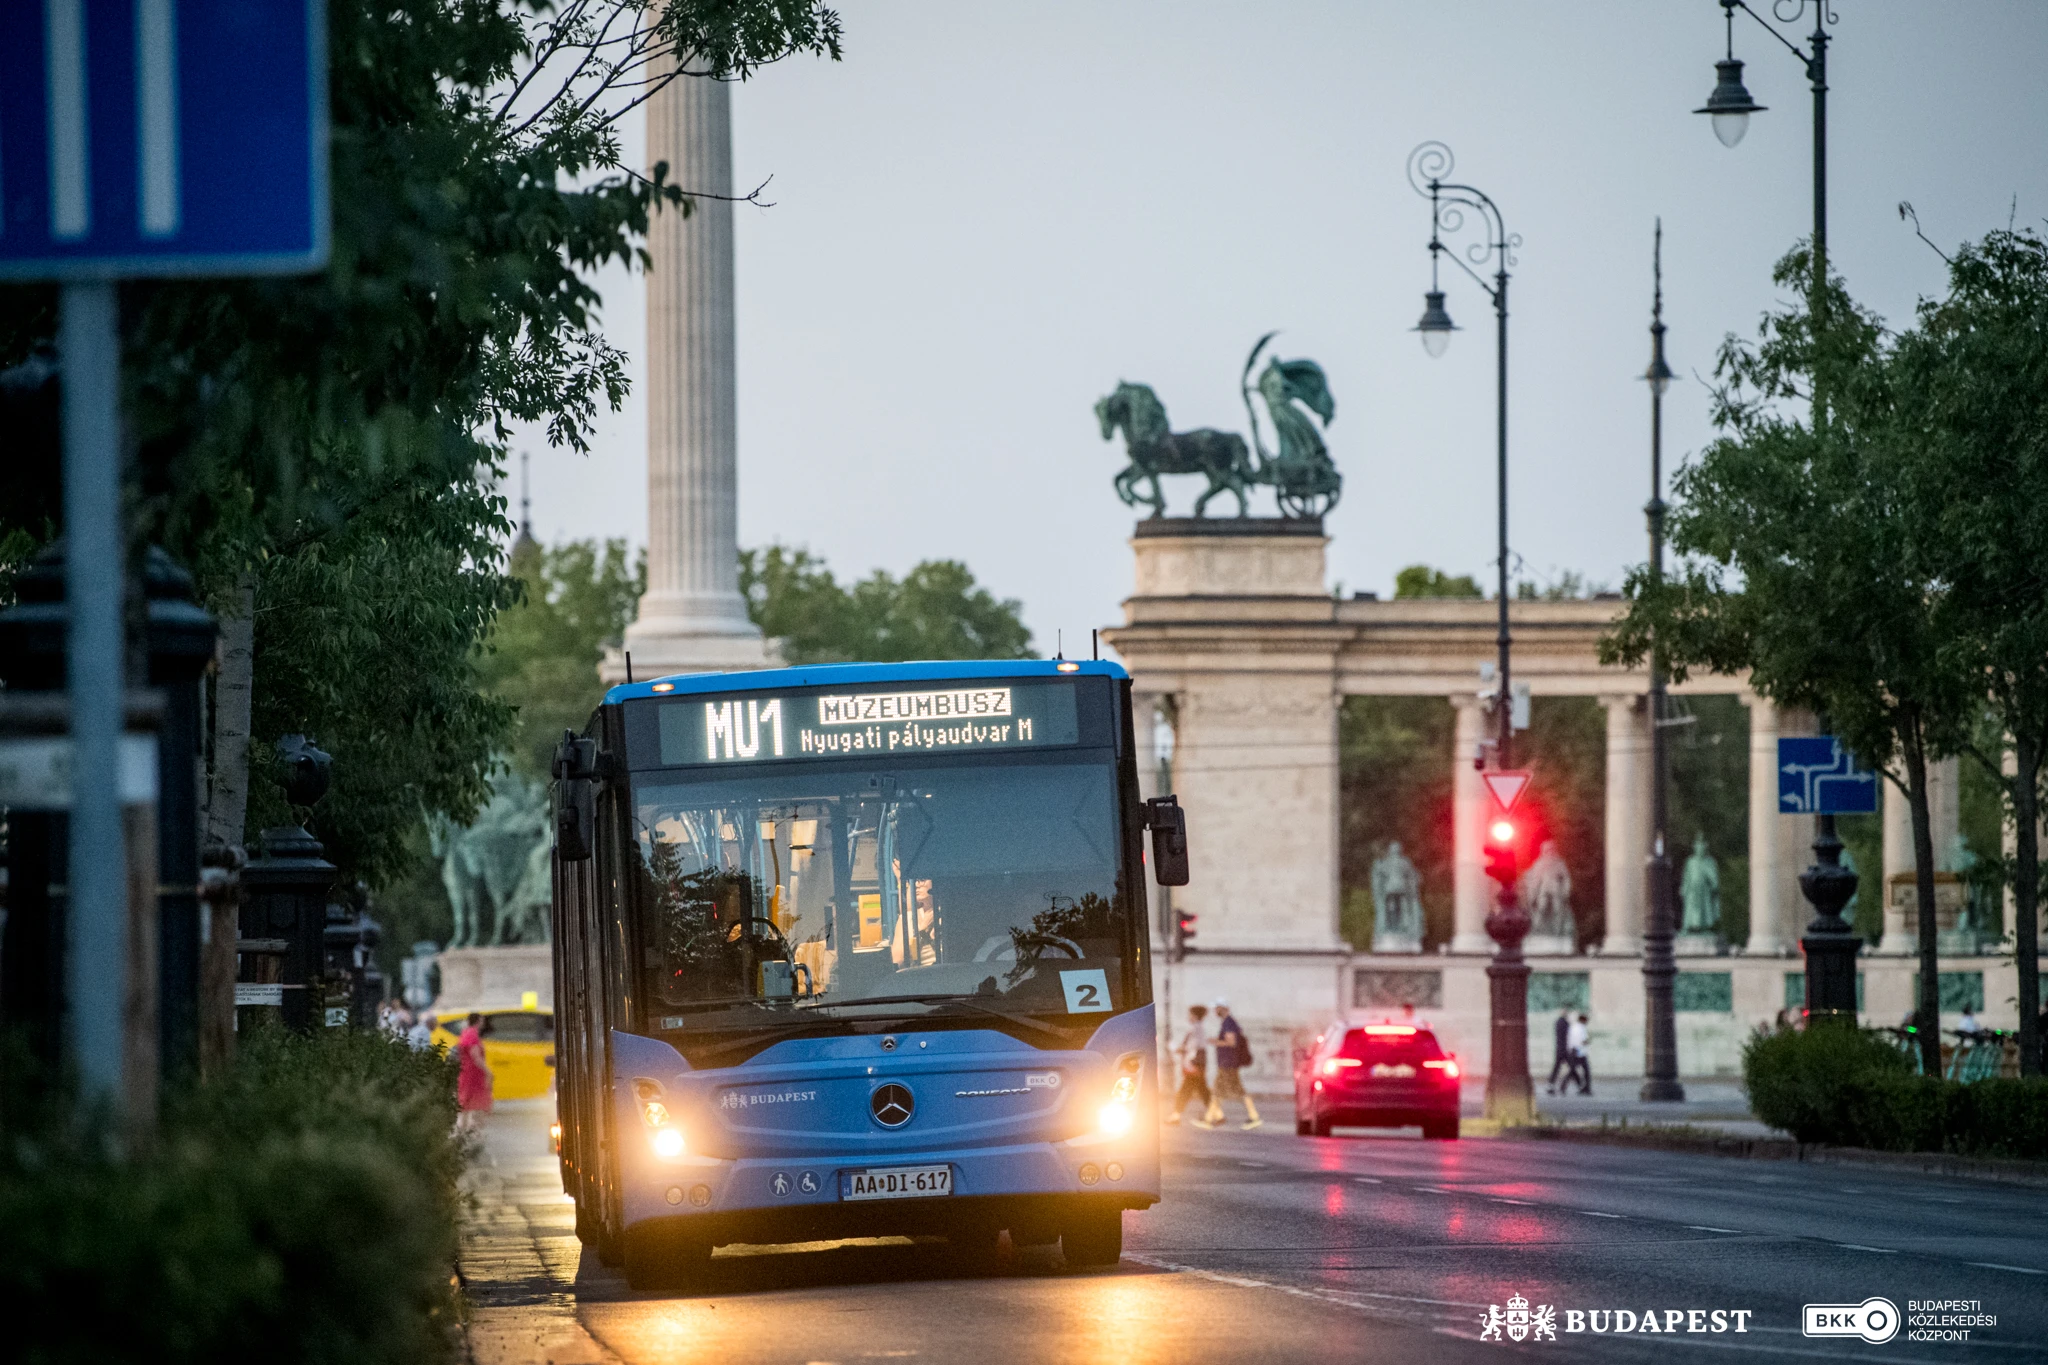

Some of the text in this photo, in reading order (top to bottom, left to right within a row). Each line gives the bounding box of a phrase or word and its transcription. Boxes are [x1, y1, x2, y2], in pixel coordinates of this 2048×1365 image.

[823, 691, 1007, 722] MÚZEUMBUSZ
[705, 699, 783, 759] MU1
[801, 718, 1033, 754] Nyugati pályaudvar M
[1075, 984, 1101, 1007] 2
[750, 1091, 816, 1105] BUDAPEST
